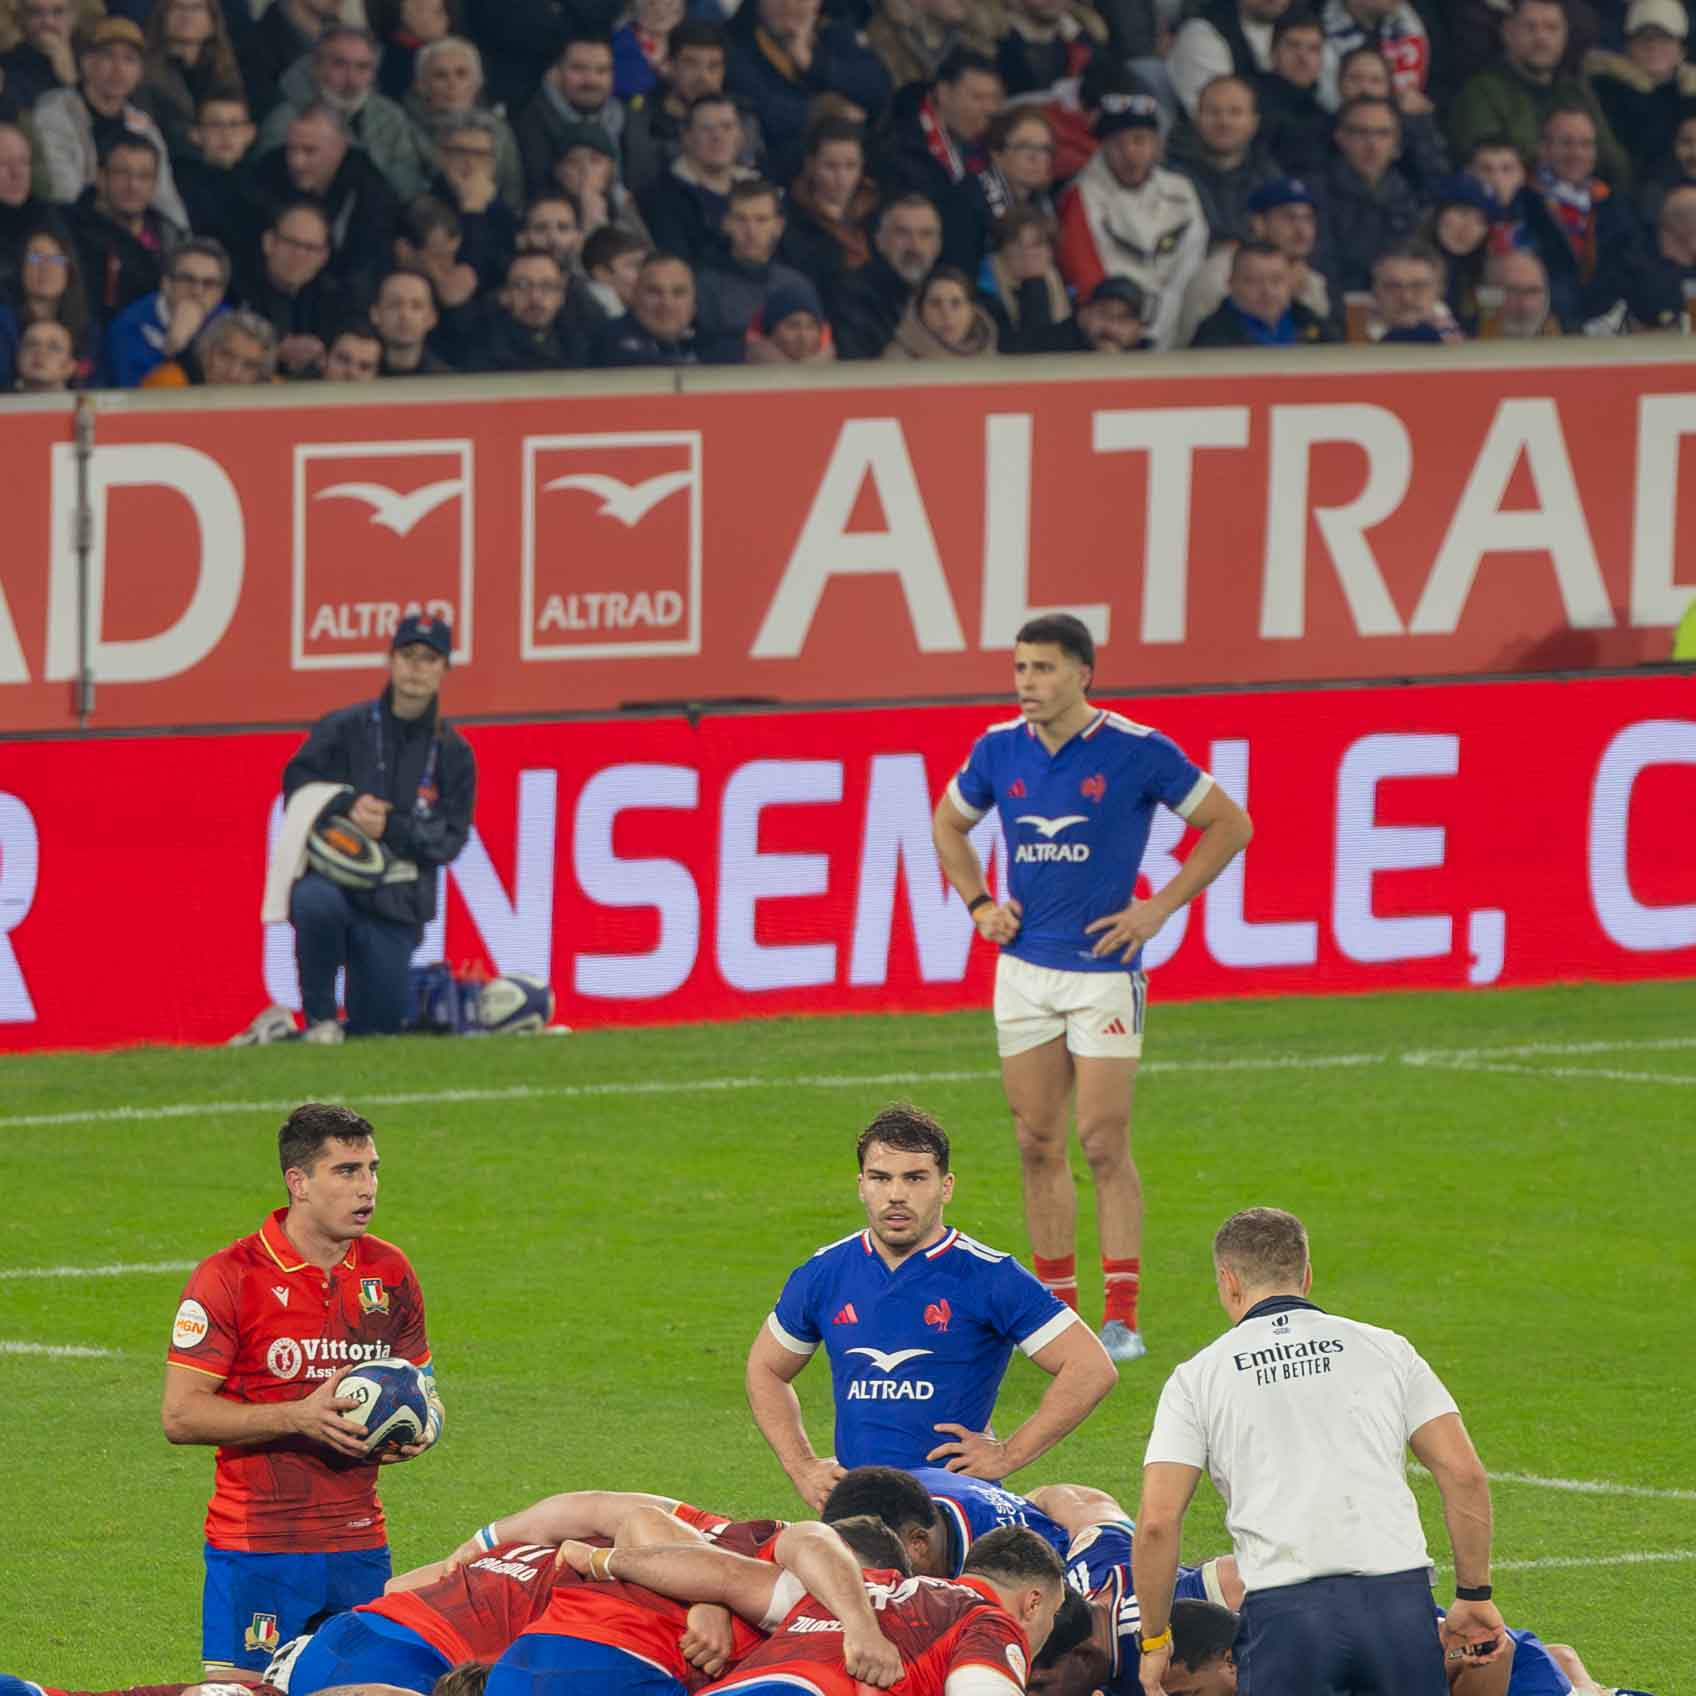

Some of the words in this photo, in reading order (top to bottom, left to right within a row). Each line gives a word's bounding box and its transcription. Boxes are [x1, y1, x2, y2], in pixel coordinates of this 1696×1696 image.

[538, 590, 683, 630] ALTRAD
[1015, 842, 1090, 863] ALTRAD
[301, 1337, 391, 1361] Vittoria
[1232, 1338, 1345, 1372] Emirates
[1256, 1366, 1278, 1387] FLY
[1283, 1356, 1332, 1380] BETTER
[847, 1380, 934, 1400] ALTRAD
